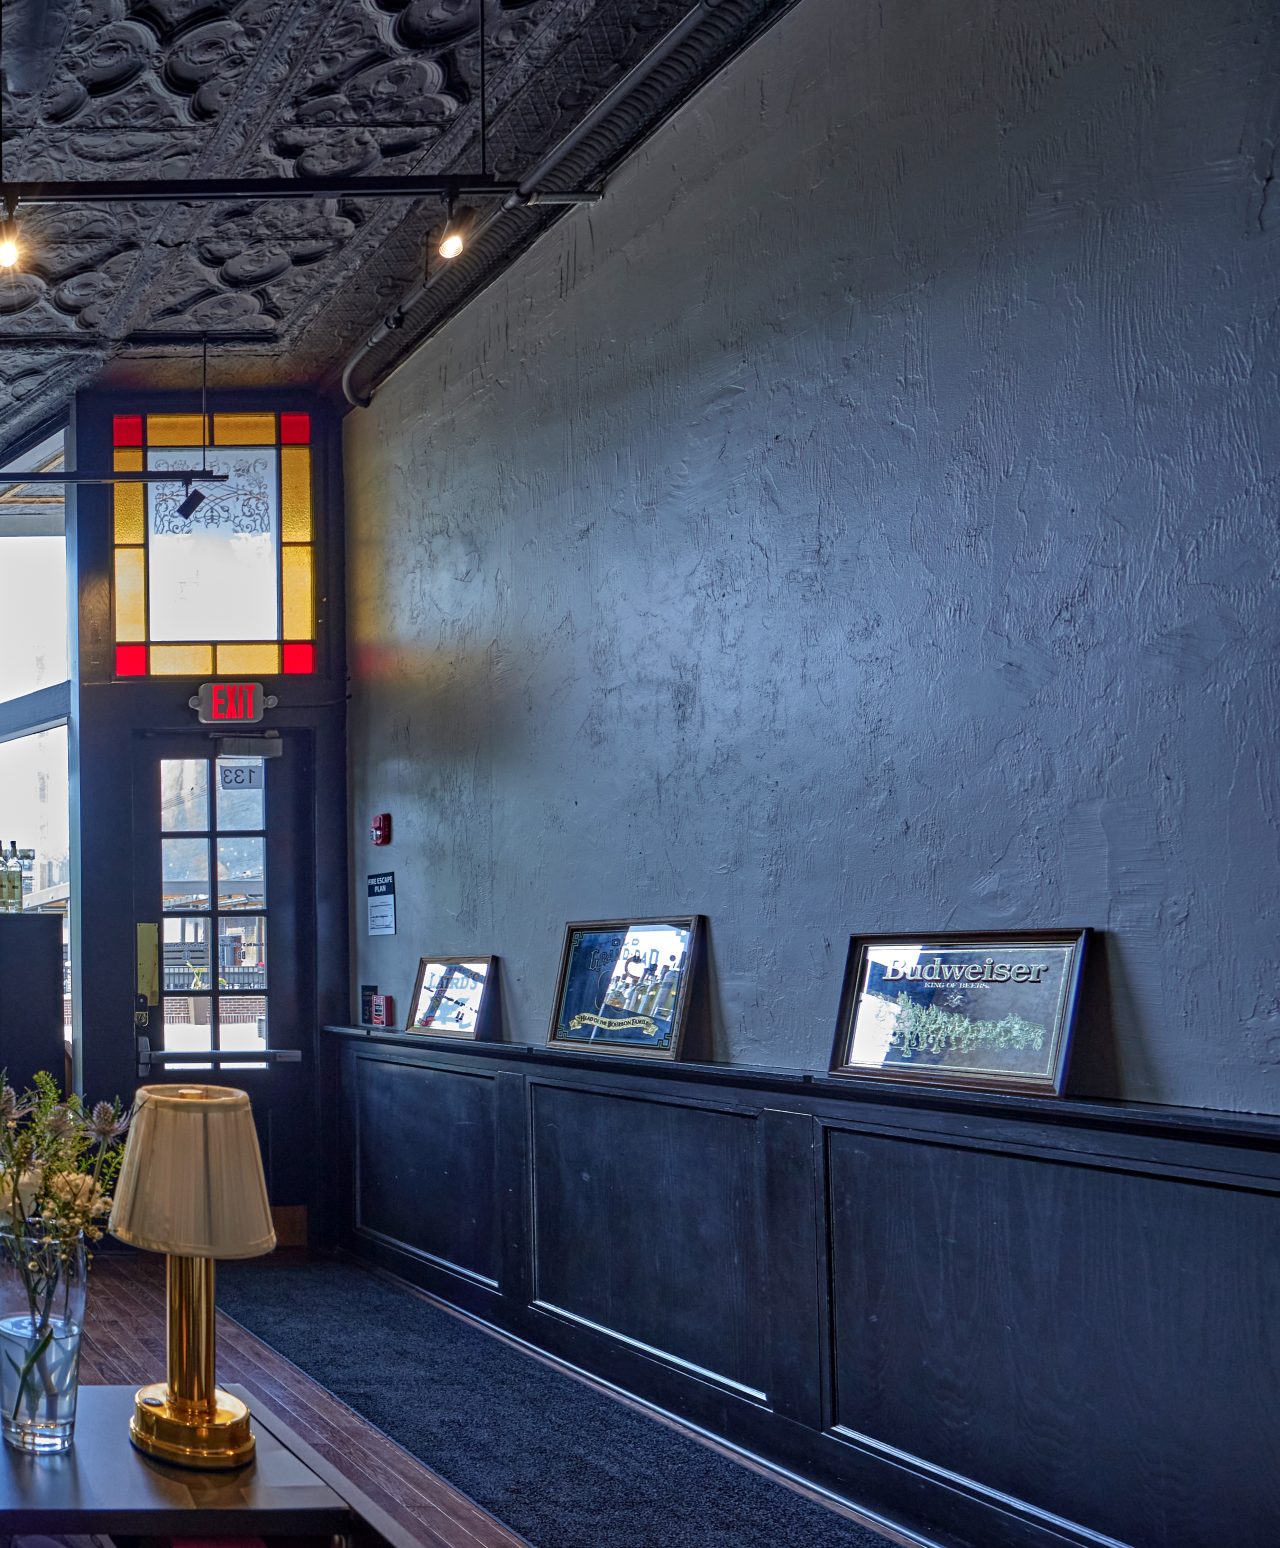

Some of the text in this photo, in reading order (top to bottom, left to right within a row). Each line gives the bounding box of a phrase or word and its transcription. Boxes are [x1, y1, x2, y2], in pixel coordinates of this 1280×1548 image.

[211, 684, 256, 720] EXIT
[374, 884, 387, 893] PLAN
[377, 875, 393, 884] ESCAPE
[882, 957, 1048, 984] Budweiser
